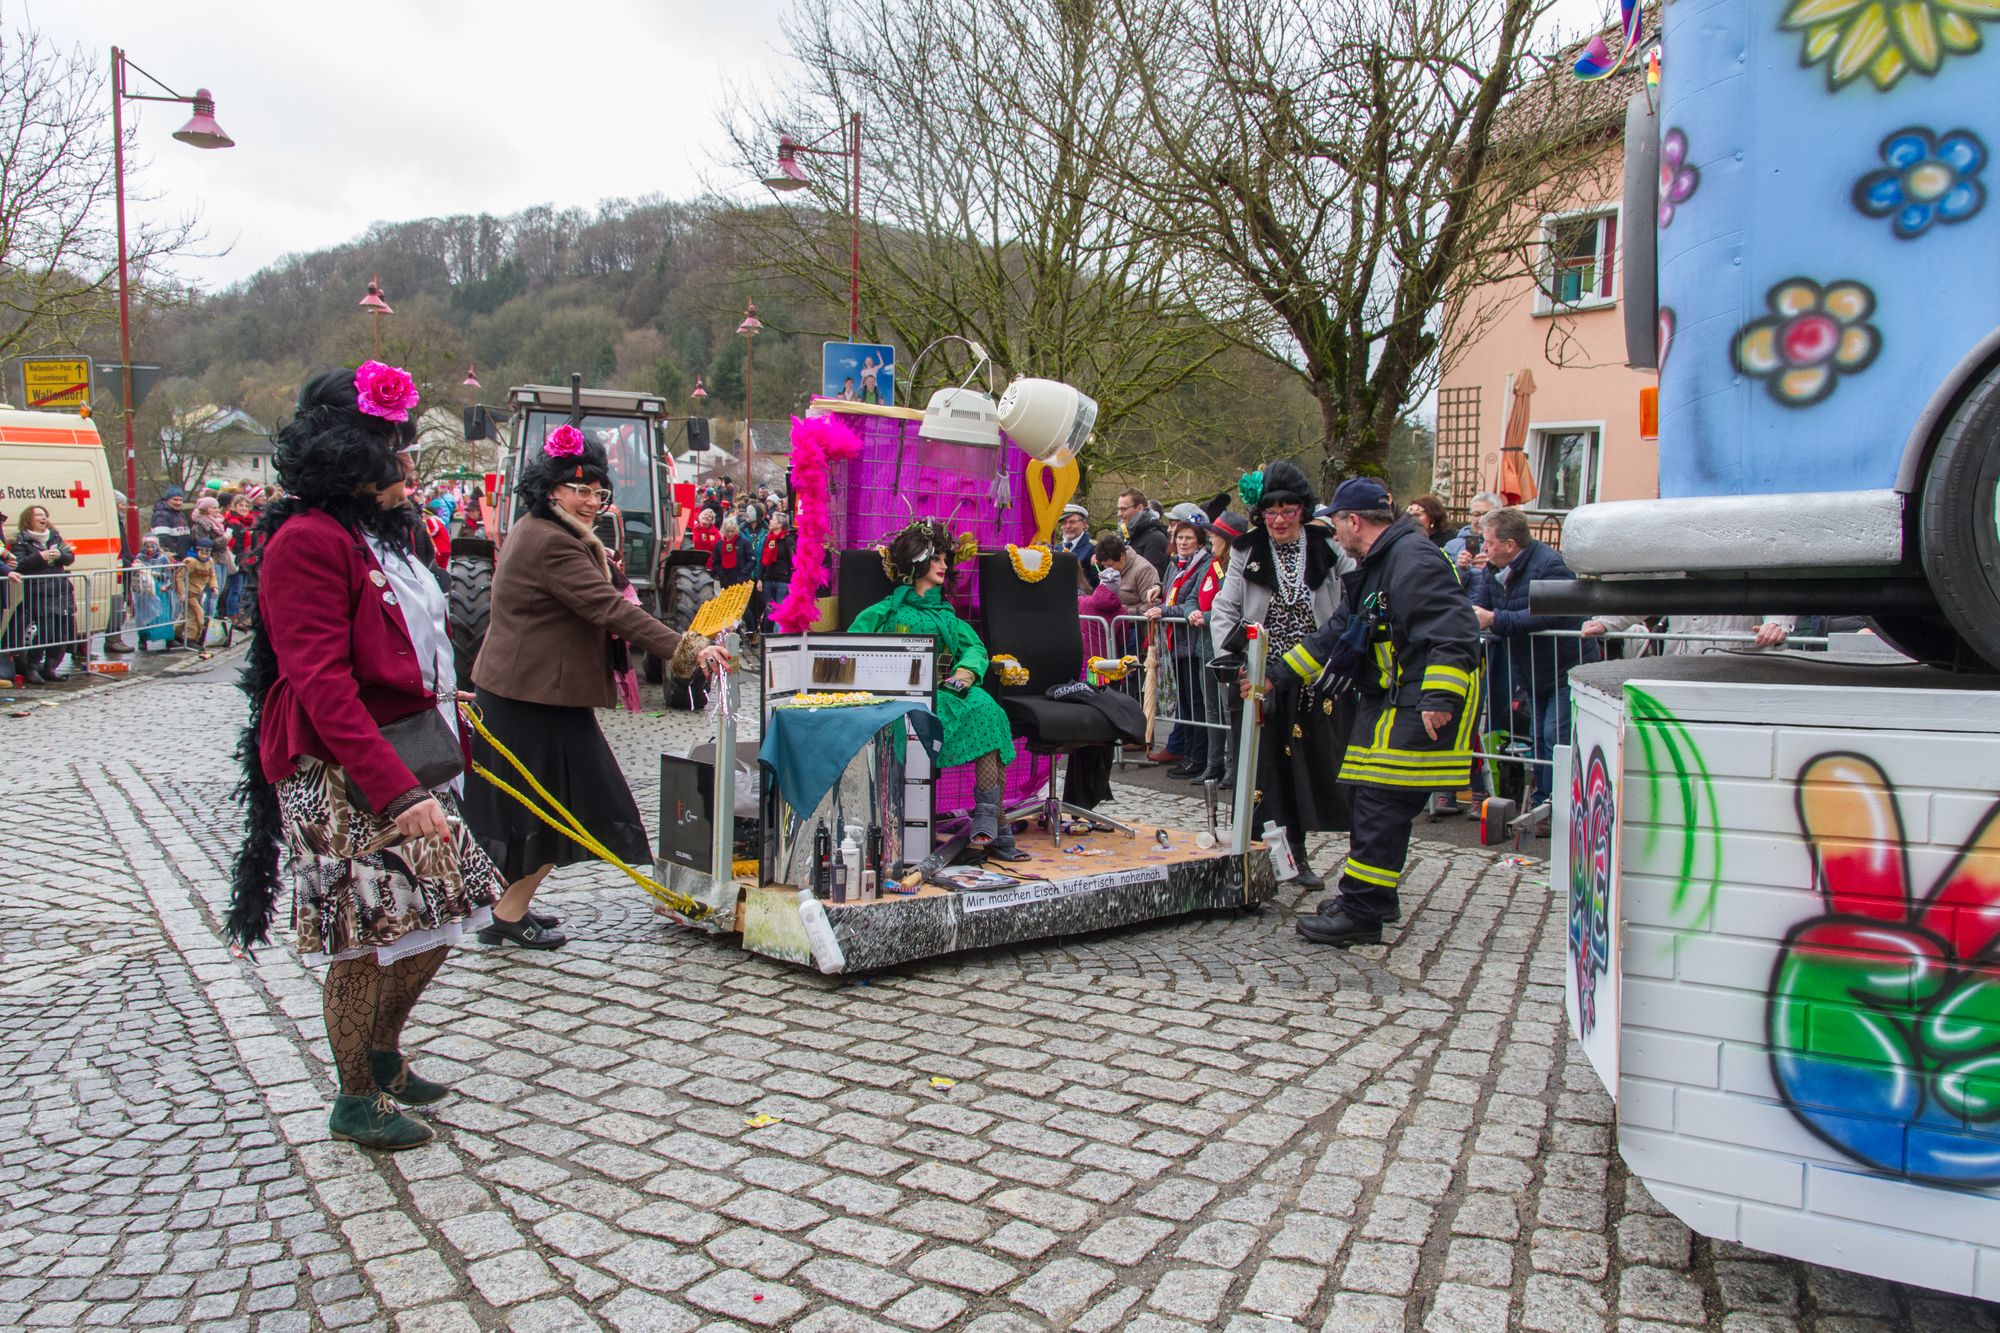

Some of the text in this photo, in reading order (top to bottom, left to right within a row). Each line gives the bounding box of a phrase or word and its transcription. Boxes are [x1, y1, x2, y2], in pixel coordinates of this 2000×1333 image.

[32, 388, 84, 401] Wallendorf
[8, 486, 36, 499] Rotes
[38, 486, 67, 499] Kreuz
[966, 895, 984, 908] Mir
[989, 889, 1031, 905] maachen
[1034, 885, 1060, 898] Eisch
